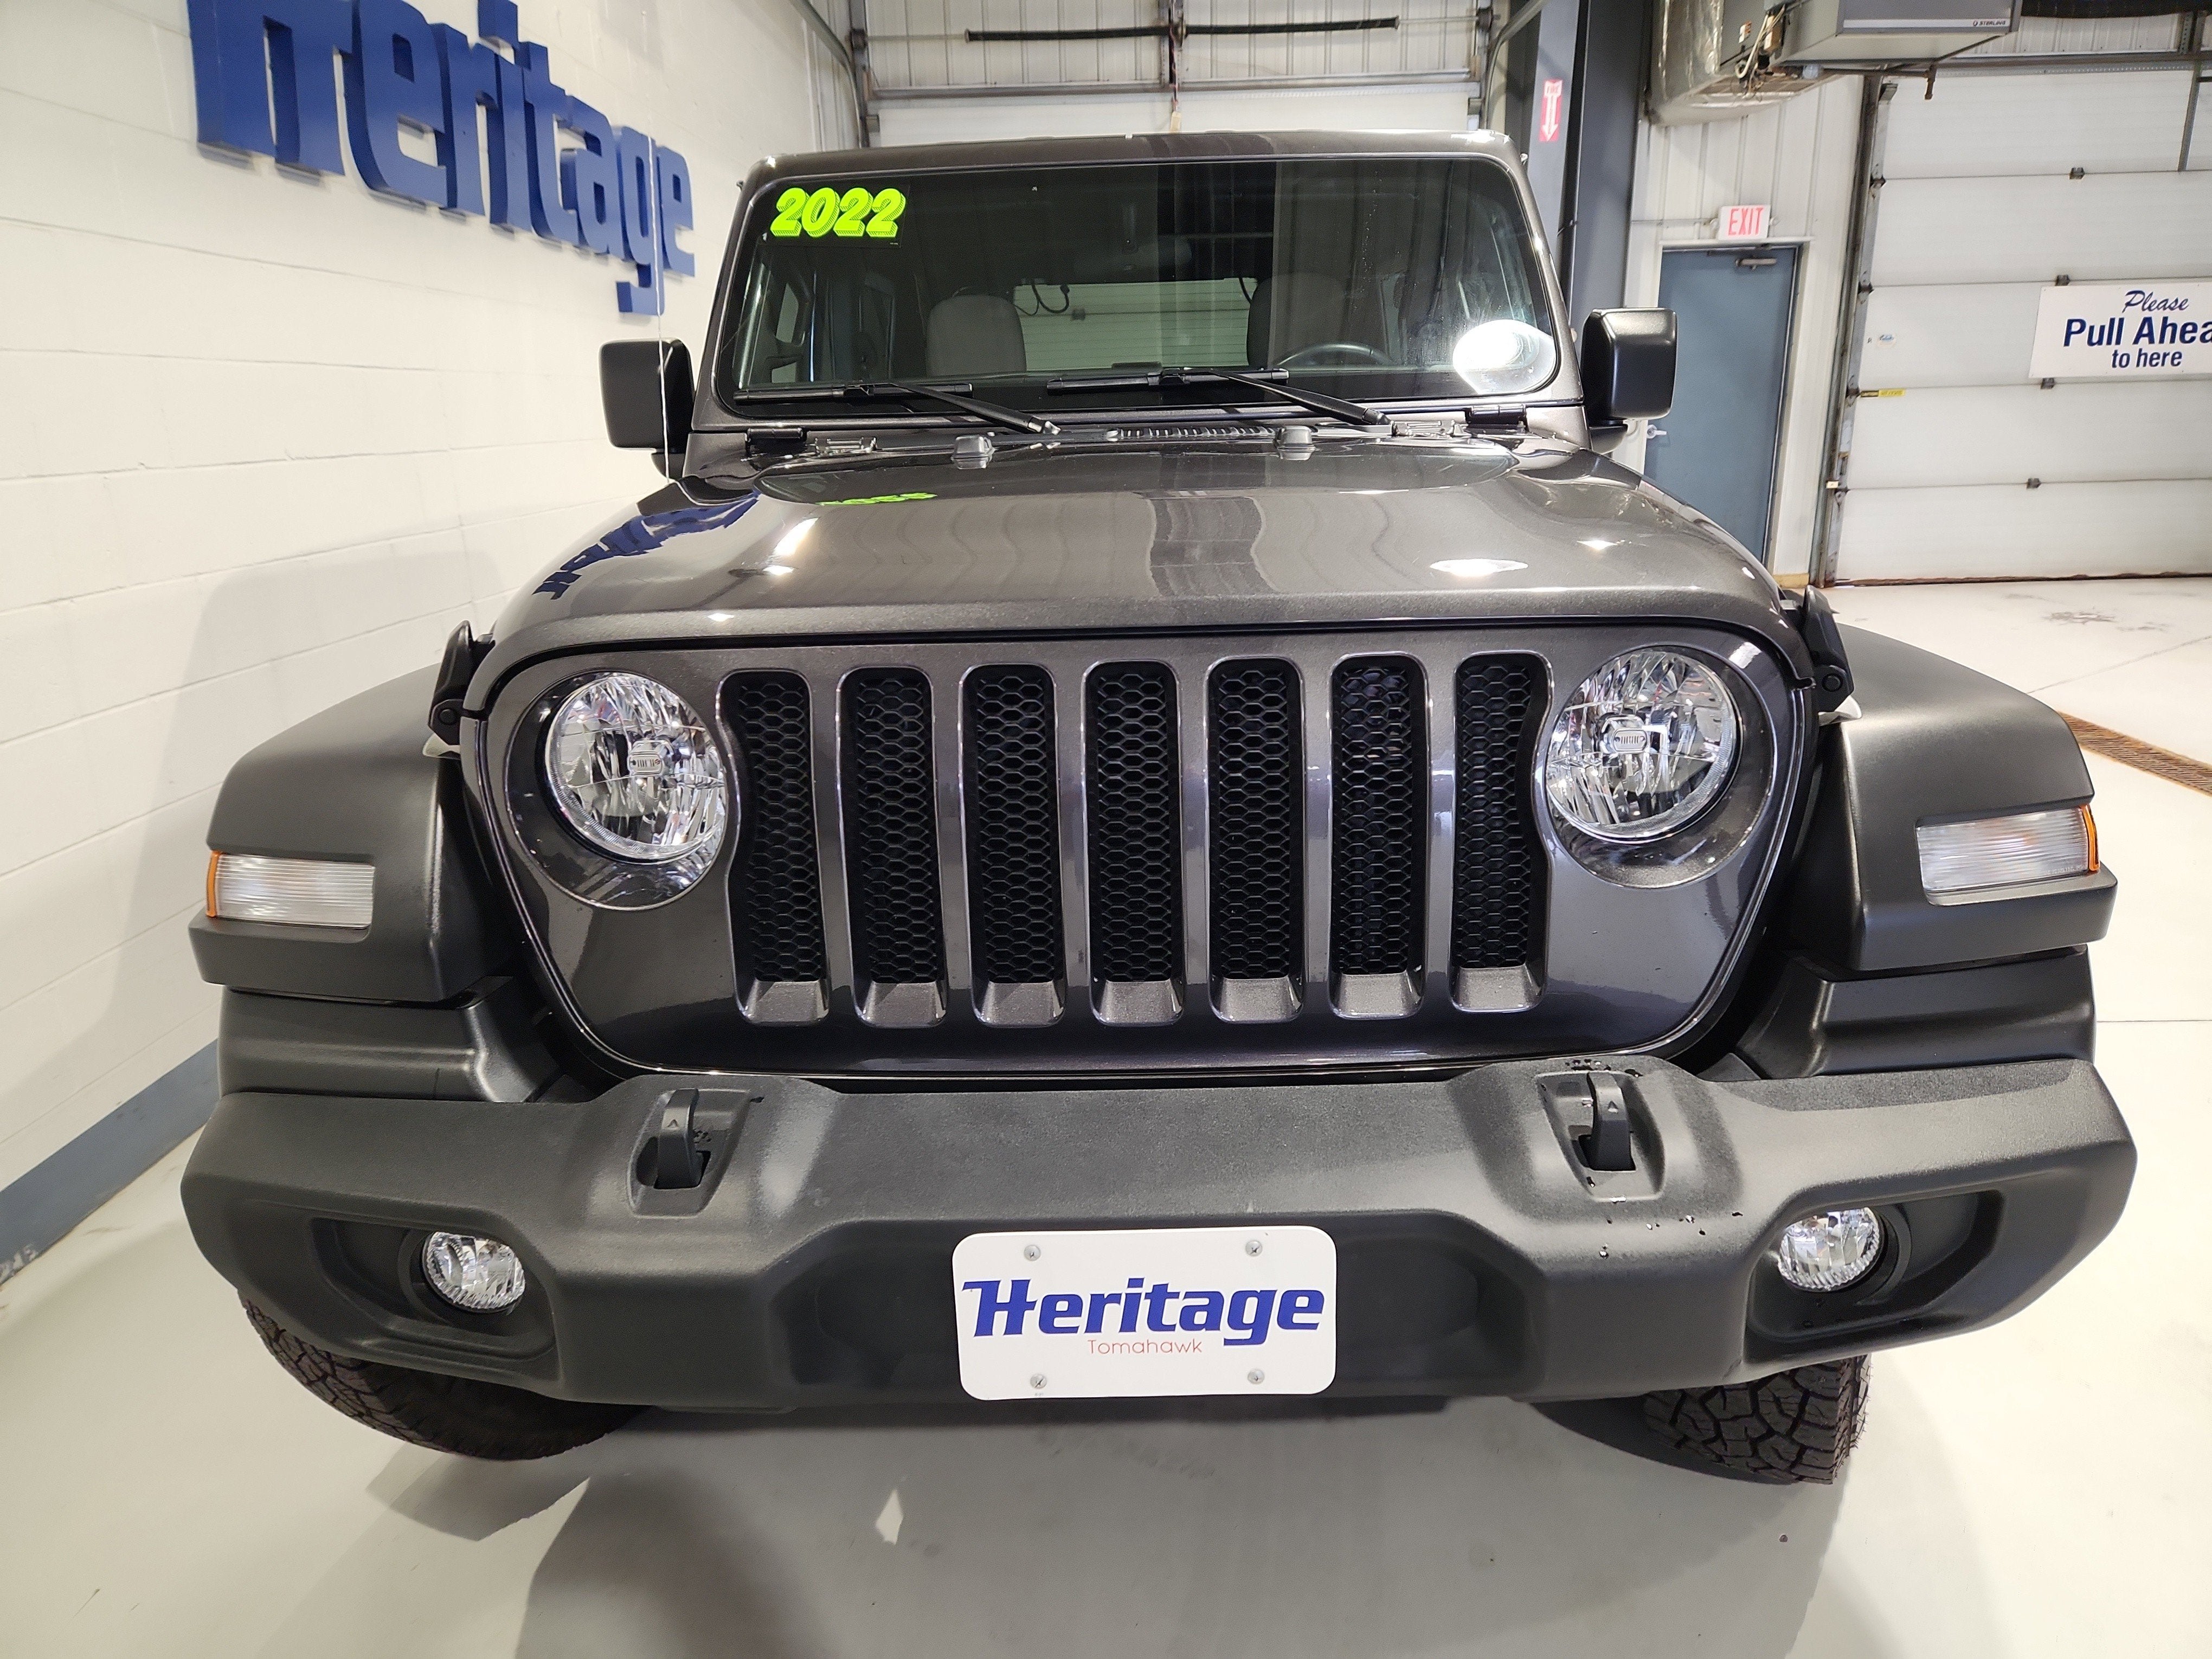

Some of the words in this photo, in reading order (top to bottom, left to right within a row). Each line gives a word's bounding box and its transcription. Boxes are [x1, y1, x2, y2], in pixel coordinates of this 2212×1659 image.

[770, 187, 906, 237] 2022
[1728, 208, 1763, 235] EXIT
[2122, 290, 2189, 313] Please
[2063, 317, 2125, 347] Pull
[2112, 350, 2131, 368] to
[2136, 348, 2182, 368] here
[962, 1277, 1324, 1346] Heritage
[1088, 1339, 1202, 1354] Tomahawk
